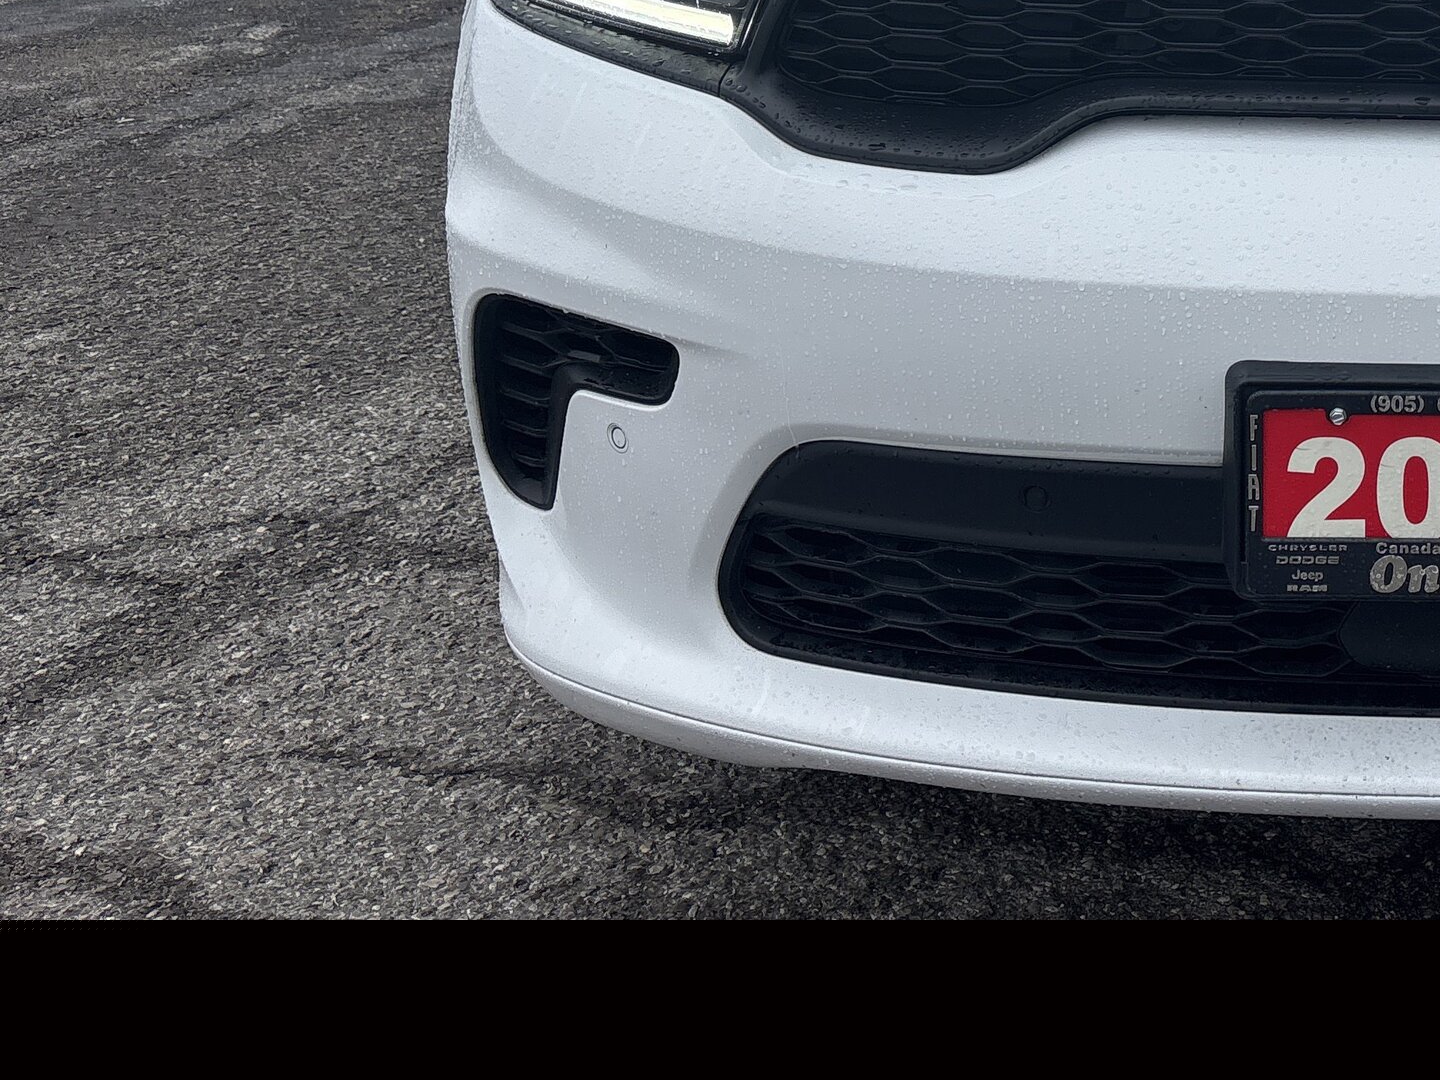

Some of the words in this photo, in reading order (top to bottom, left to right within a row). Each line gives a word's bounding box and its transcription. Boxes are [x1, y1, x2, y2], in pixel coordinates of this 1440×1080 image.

[1370, 395, 1425, 413] (905)
[1248, 414, 1261, 532] FIAT
[1267, 544, 1348, 552] CHRYSLER
[1275, 555, 1340, 565] DODGE
[1291, 569, 1324, 582] Jeep
[1286, 584, 1328, 592] RAM
